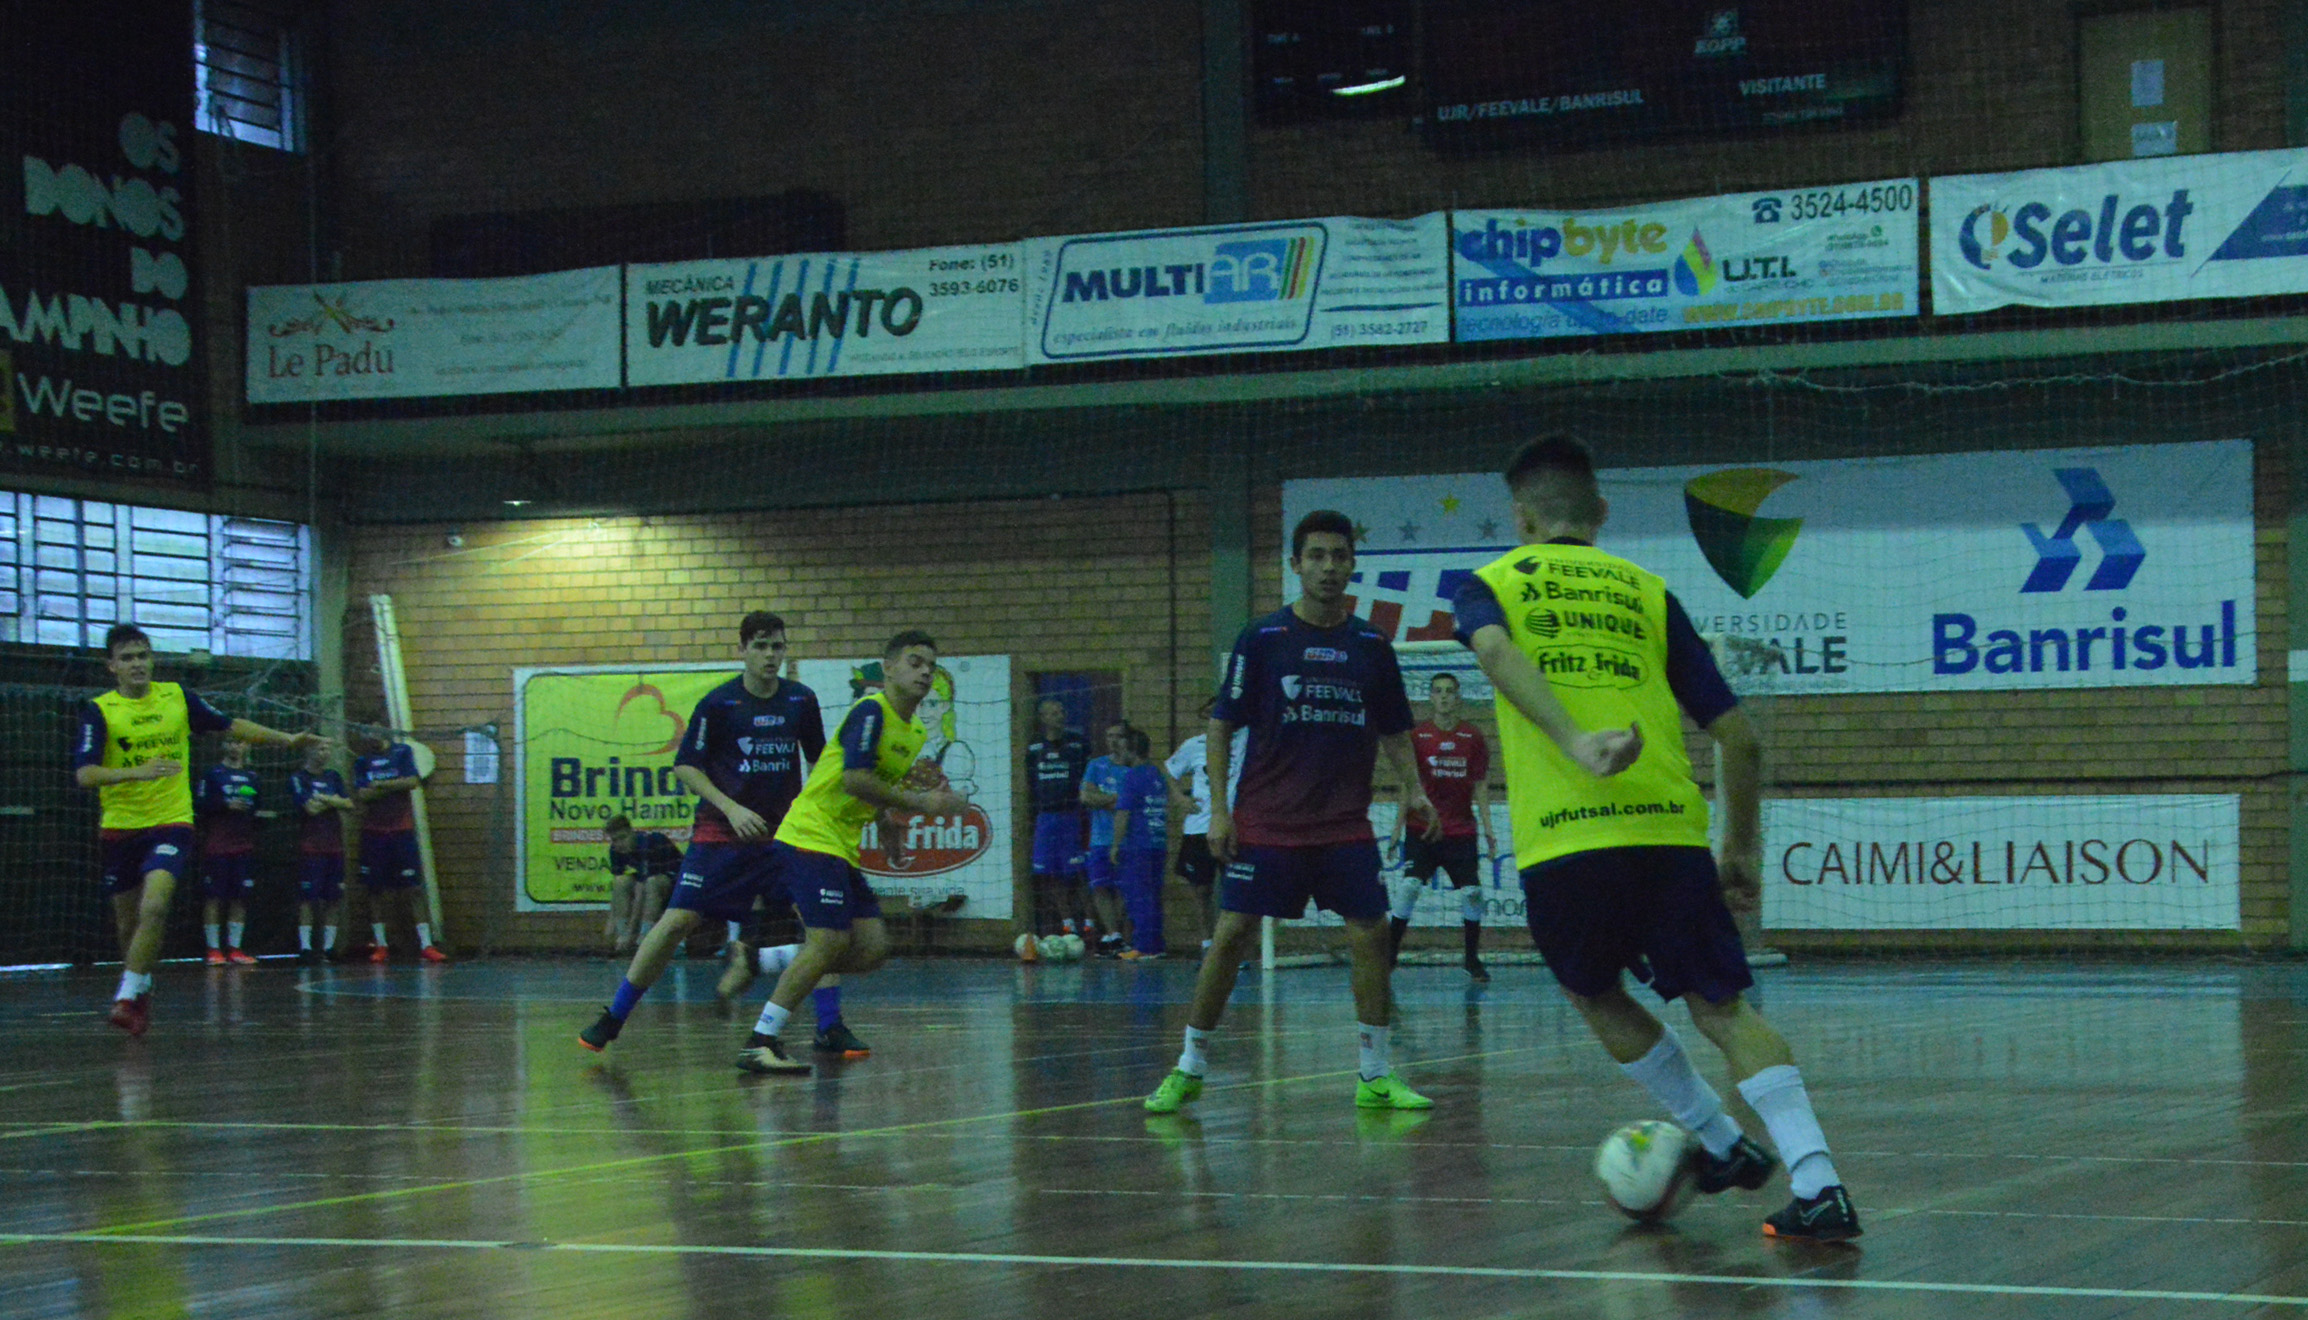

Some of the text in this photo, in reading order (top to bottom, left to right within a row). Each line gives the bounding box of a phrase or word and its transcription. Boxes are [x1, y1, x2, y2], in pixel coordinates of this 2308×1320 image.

[1739, 74, 1826, 96] VISITANTE
[1791, 184, 1913, 221] 3524-4500
[1461, 217, 1668, 268] chipbyte
[2006, 189, 2194, 269] Selet
[928, 253, 1015, 273] Fone: (51)
[1464, 275, 1664, 303] informática
[645, 287, 923, 348] WERANTO
[268, 344, 304, 379] Le
[314, 341, 395, 378] Padu
[17, 371, 190, 434] Weefe
[1548, 563, 1641, 591] FEEVALE
[1545, 581, 1645, 614] Banrisul
[1563, 610, 1647, 640] UNIQUE
[1933, 600, 2237, 675] Banrisul
[1300, 704, 1366, 726] Banrisul
[550, 799, 612, 821] Novo
[1540, 799, 1686, 828] ujrfutsal.com.br
[1782, 838, 2210, 886] CAIMI&LIAISON
